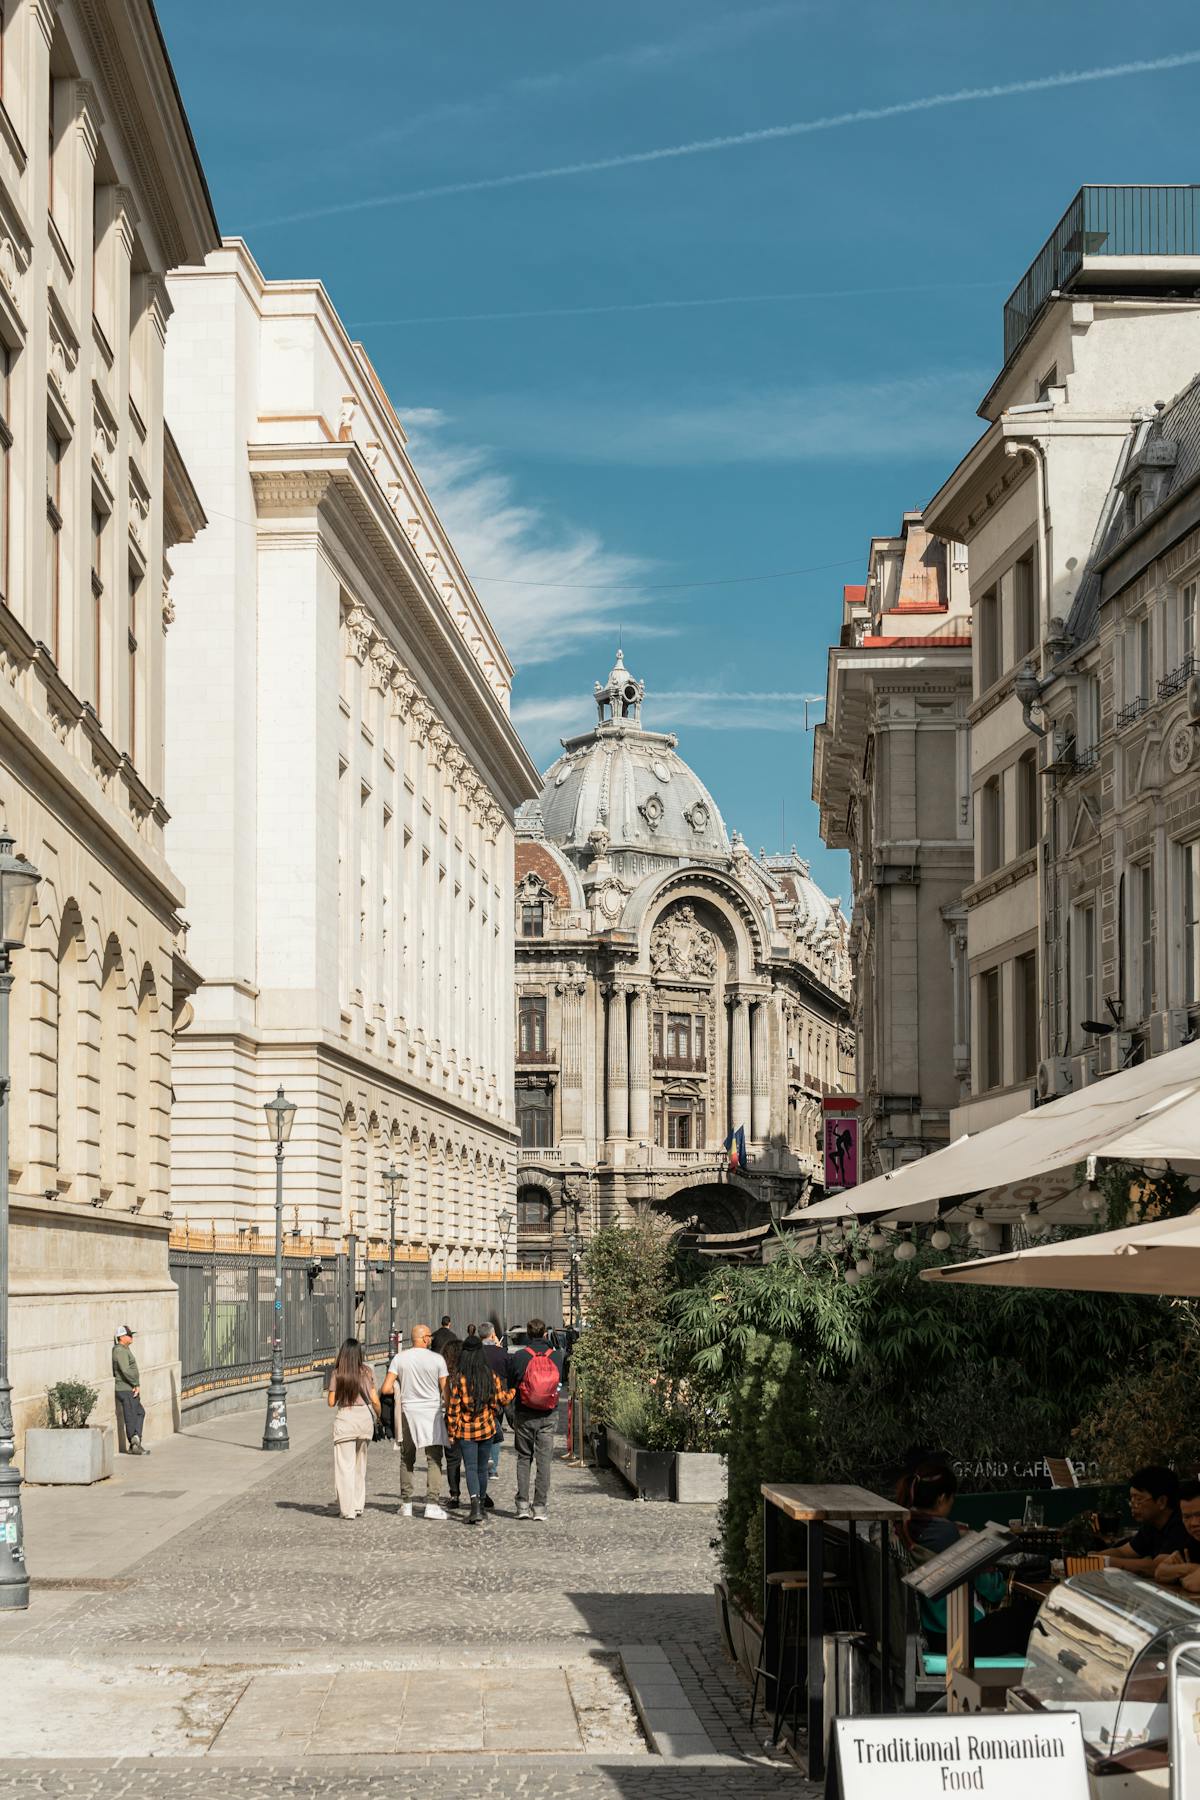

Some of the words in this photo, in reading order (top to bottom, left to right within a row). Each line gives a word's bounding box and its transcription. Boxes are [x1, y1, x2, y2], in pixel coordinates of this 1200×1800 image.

[952, 1461, 1008, 1477] GRAND
[1013, 1460, 1051, 1477] CAFE
[853, 1737, 961, 1764] Traditional
[967, 1734, 1065, 1761] Romanian
[940, 1766, 985, 1791] Food
